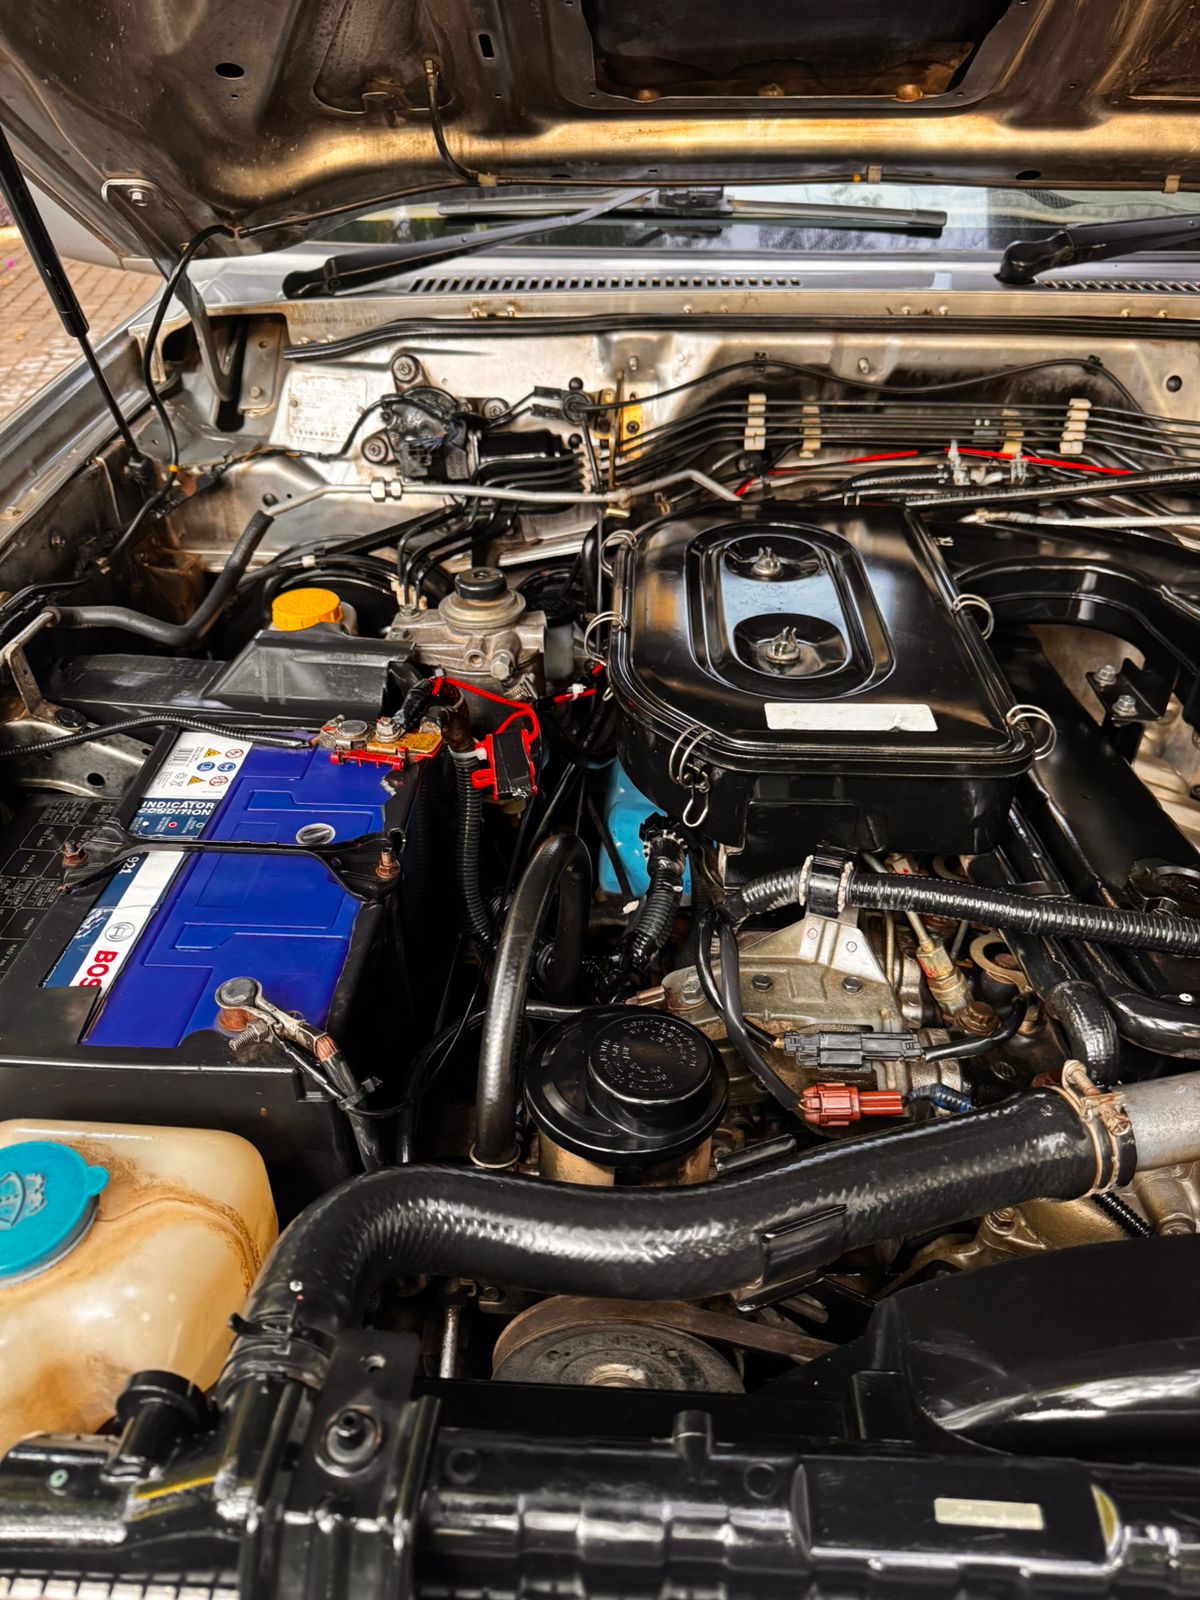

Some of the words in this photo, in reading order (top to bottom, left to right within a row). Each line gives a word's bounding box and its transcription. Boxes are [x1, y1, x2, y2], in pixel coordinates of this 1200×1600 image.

[142, 801, 215, 809] INDICATOR
[138, 808, 212, 816] CONDITION
[119, 856, 140, 874] 921
